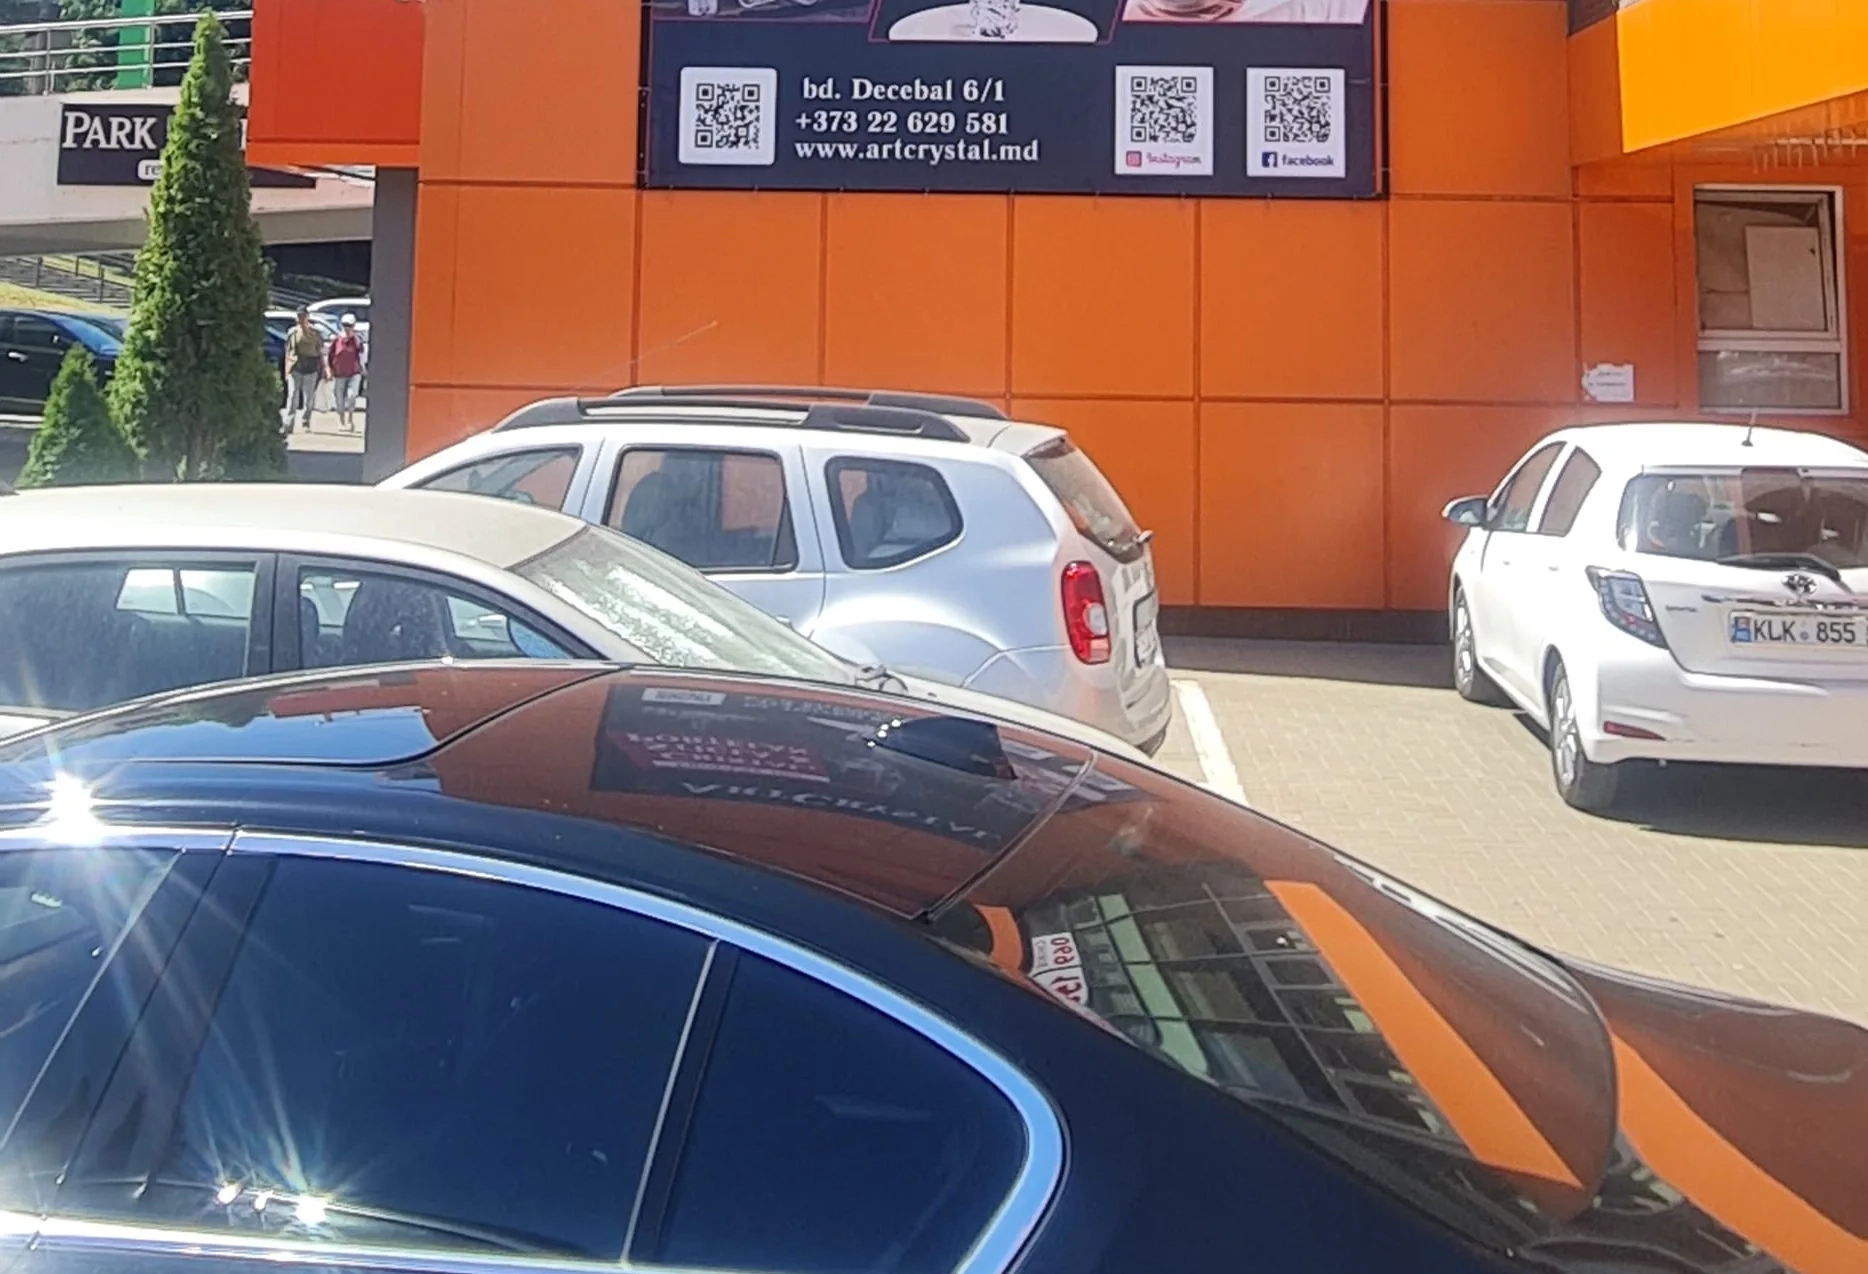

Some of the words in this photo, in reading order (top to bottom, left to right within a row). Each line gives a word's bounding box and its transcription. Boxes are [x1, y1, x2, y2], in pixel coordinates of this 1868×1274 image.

[803, 77, 842, 100] bd.
[851, 78, 953, 101] Decebal
[963, 78, 1005, 103] 6/1
[61, 111, 157, 149] PARK
[795, 110, 858, 133] +373
[867, 111, 898, 133] 22
[907, 112, 956, 134] 629
[965, 112, 1009, 135] 581
[794, 138, 1039, 166] www.artcrystal.md
[1282, 152, 1335, 166] facebook
[1754, 620, 1796, 642] KLK
[1816, 622, 1857, 643] 855
